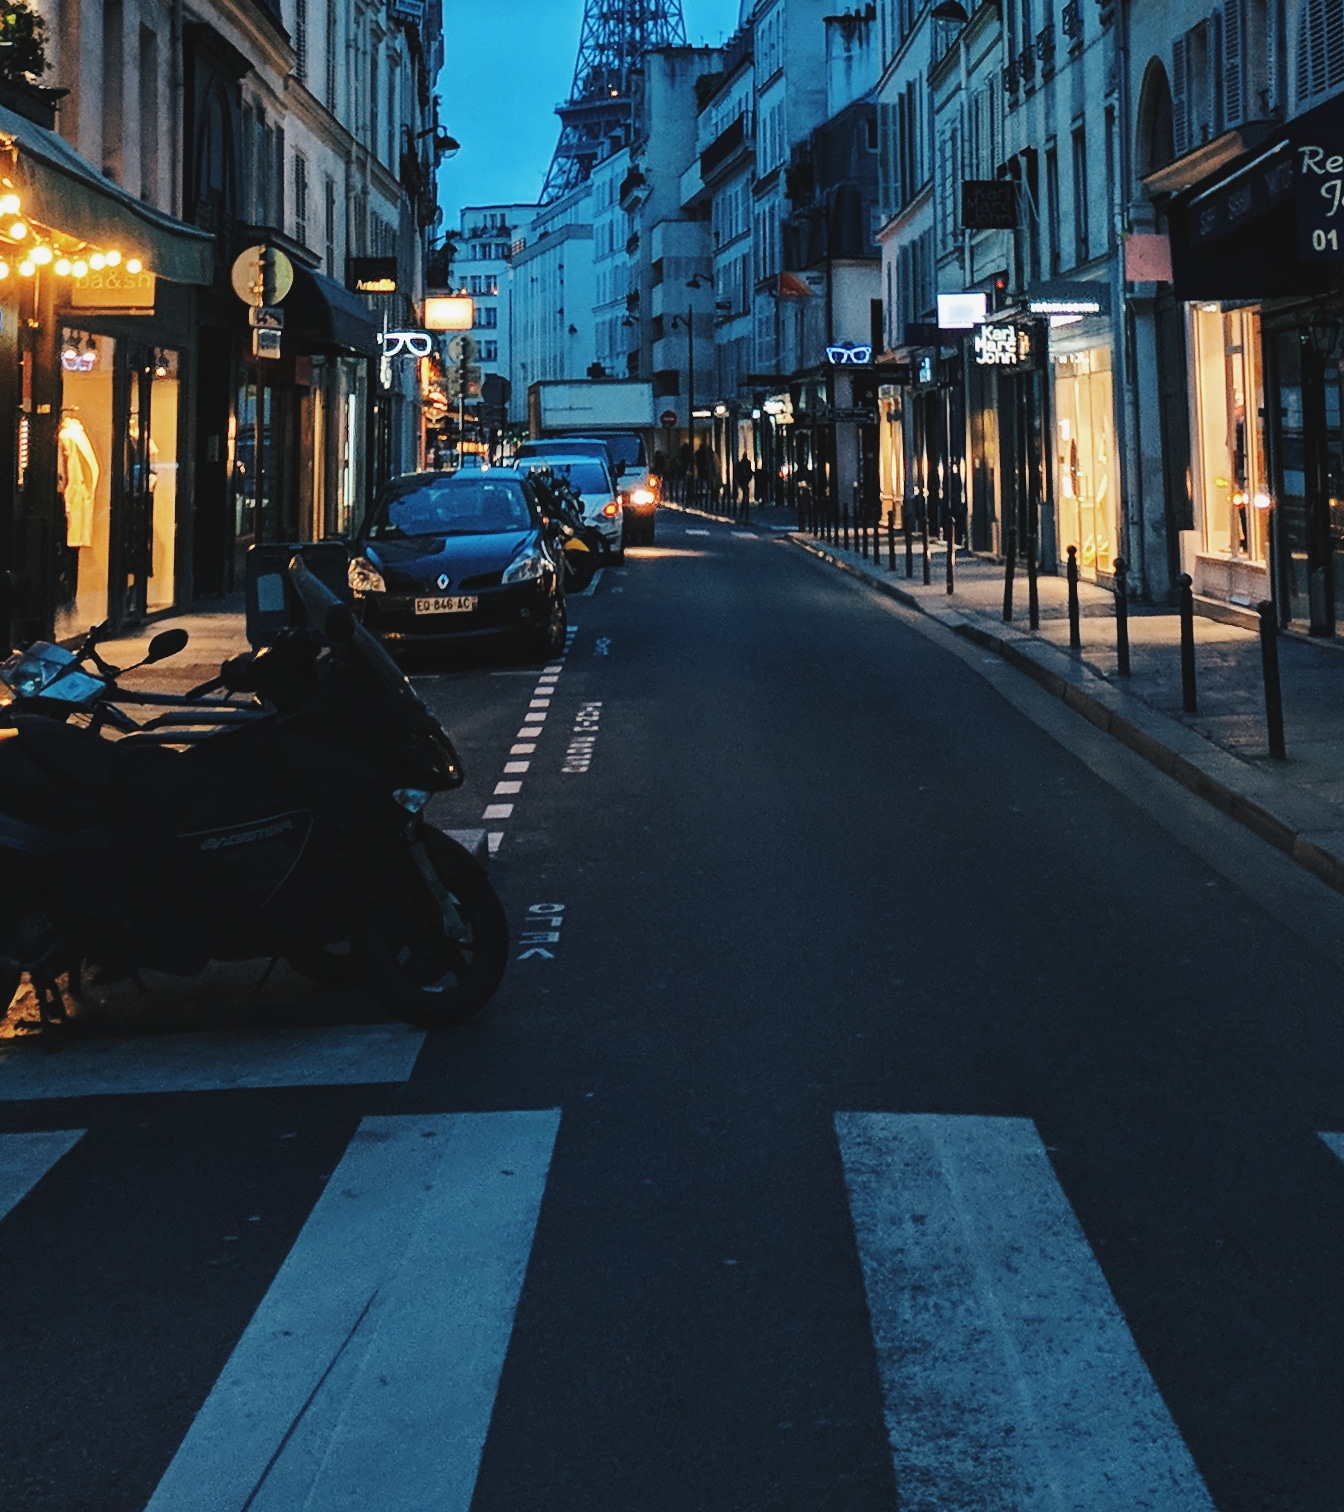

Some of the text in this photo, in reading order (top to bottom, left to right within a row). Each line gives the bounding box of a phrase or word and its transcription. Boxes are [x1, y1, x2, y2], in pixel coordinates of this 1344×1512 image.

[1312, 229, 1338, 251] 01
[980, 325, 1017, 341] Karl
[976, 350, 1017, 364] John
